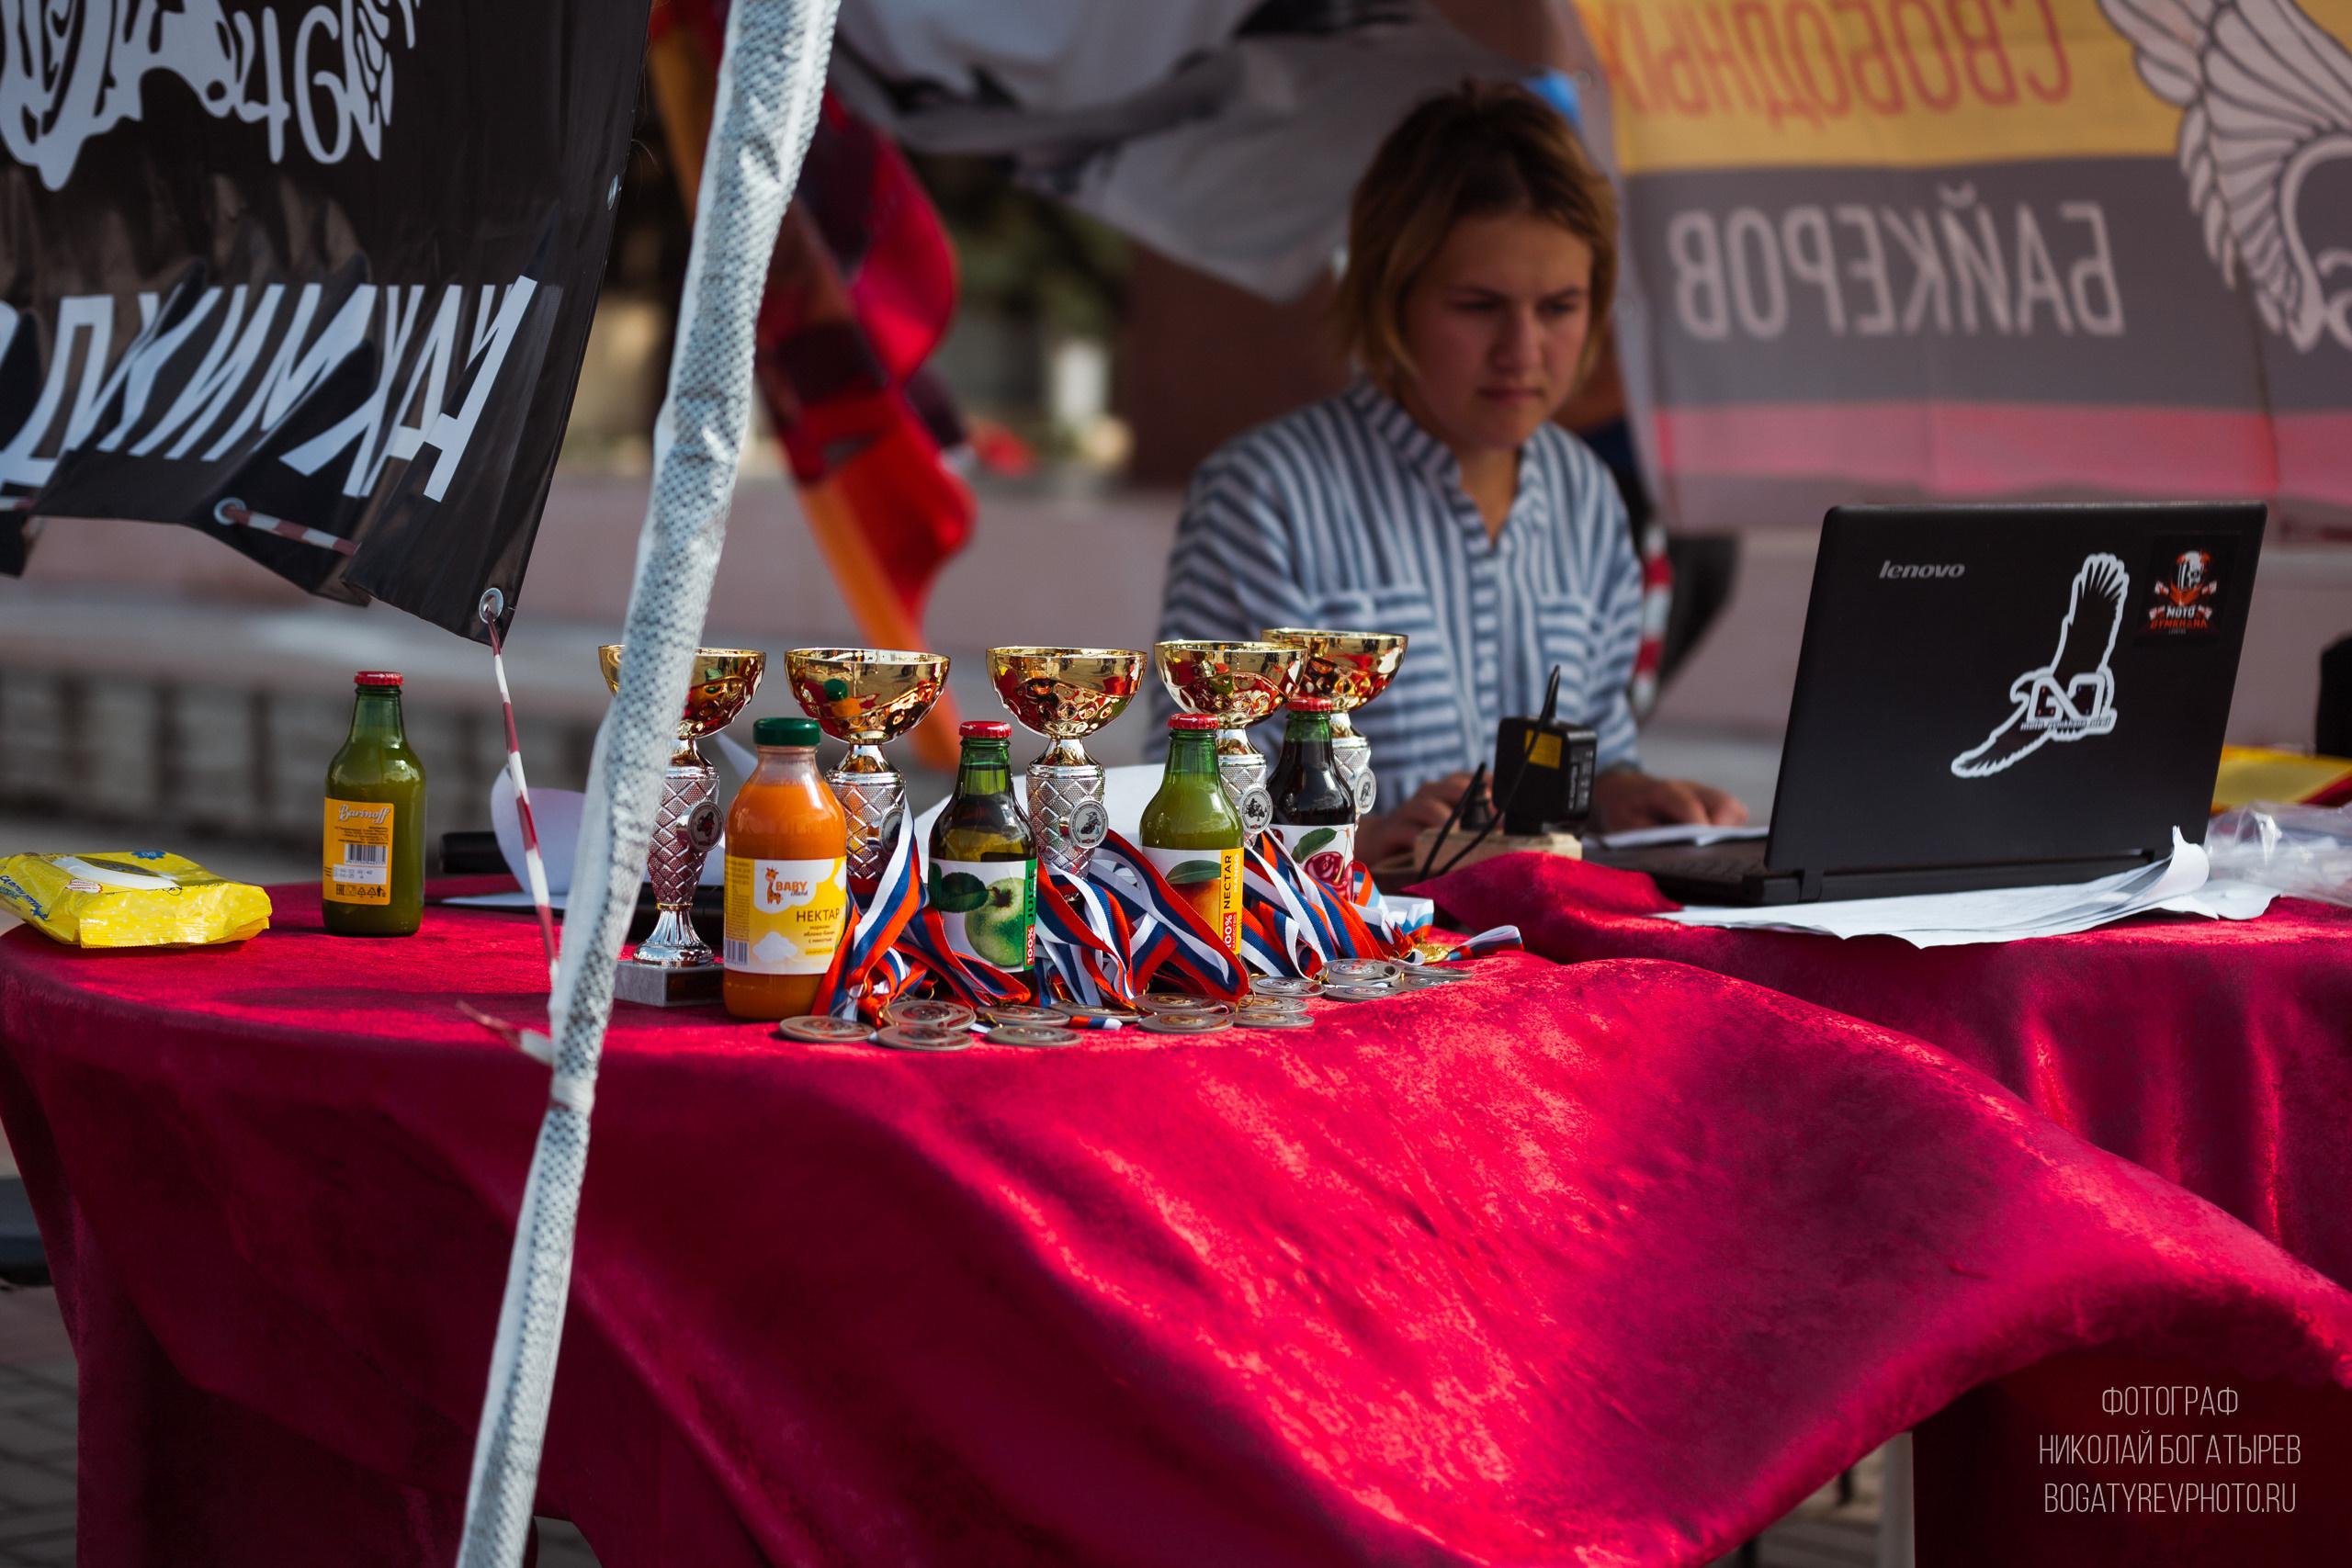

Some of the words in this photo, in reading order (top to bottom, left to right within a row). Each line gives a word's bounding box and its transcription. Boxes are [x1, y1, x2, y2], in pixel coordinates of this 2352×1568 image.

[1879, 559, 1966, 580] lenovo
[338, 804, 390, 824] Barinoff
[775, 881, 808, 892] BABY
[1223, 854, 1232, 909] NECTAR
[796, 908, 841, 923] НЕКТАР
[1224, 914, 1233, 949] 100%
